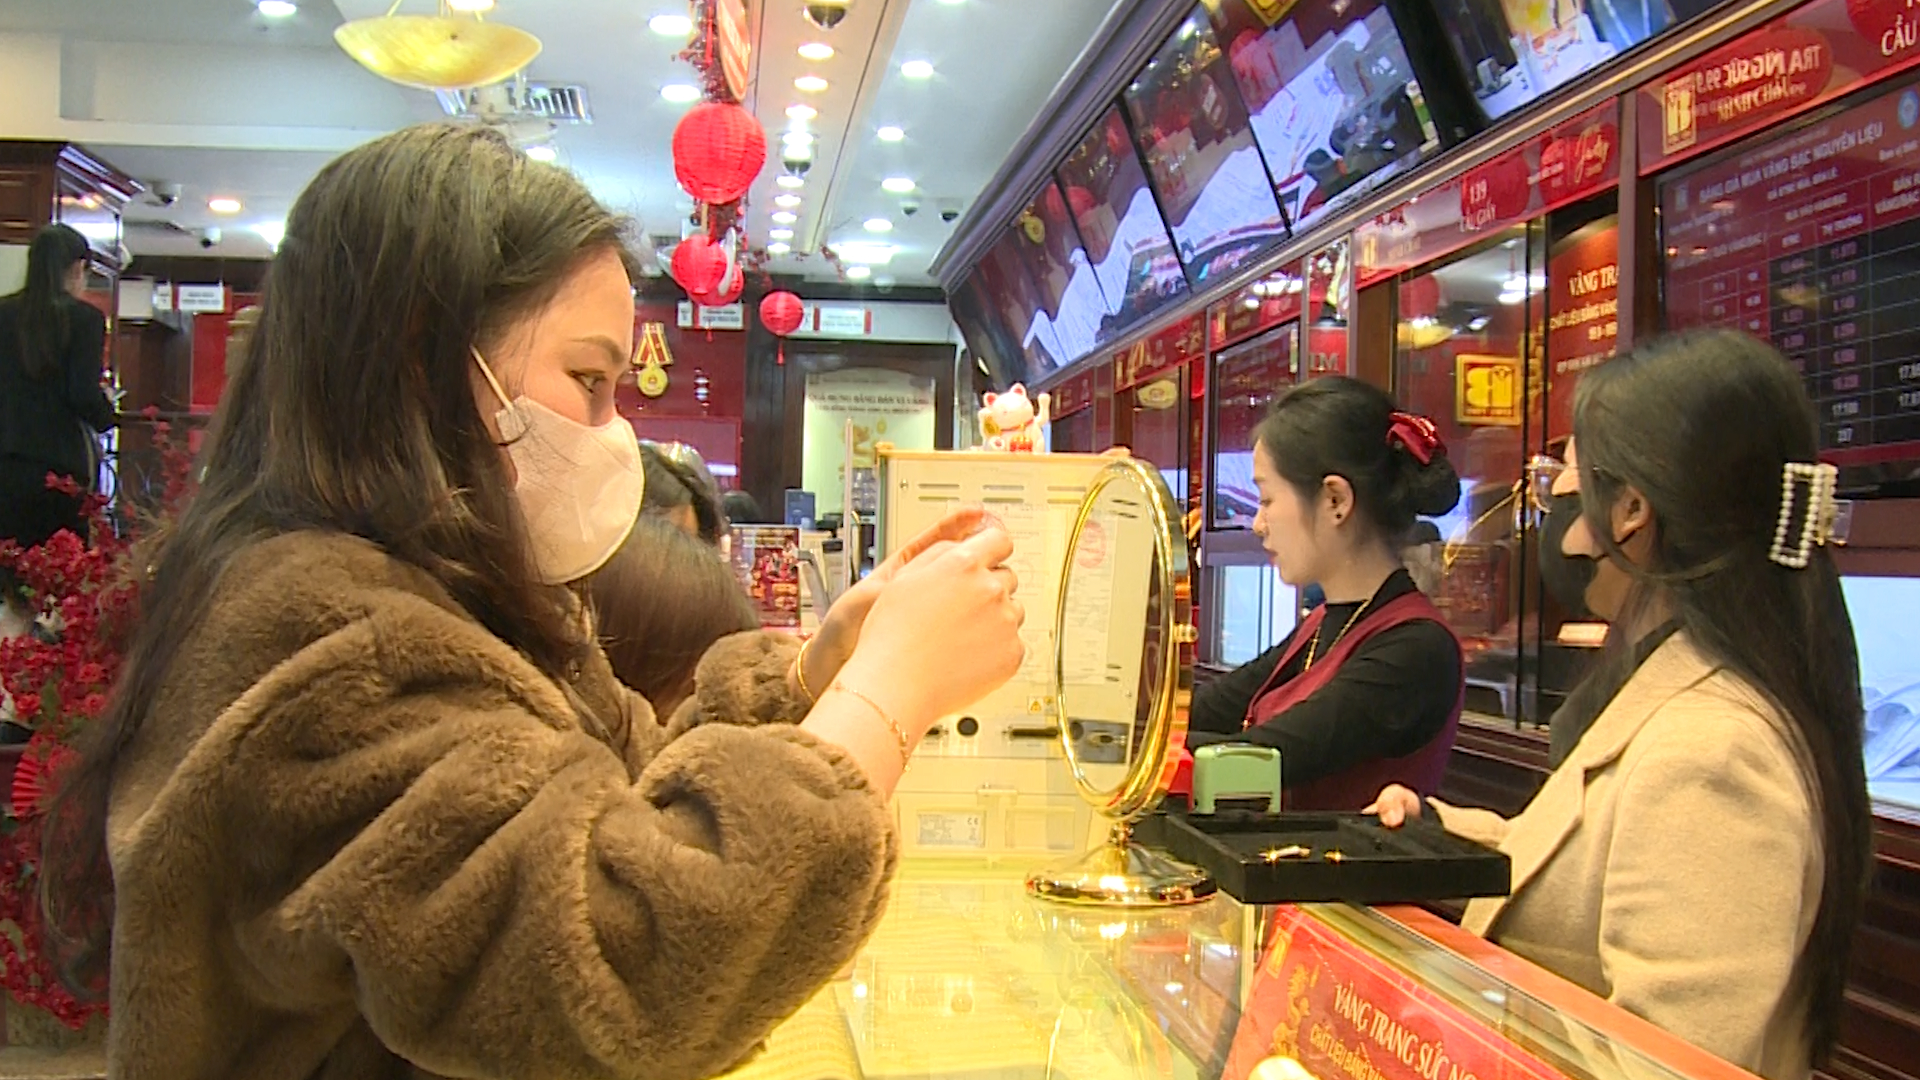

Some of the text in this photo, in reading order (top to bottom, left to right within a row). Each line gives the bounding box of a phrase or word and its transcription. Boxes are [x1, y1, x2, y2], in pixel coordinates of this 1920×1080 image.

[1881, 13, 1917, 56] CẦU
[1569, 269, 1598, 296] VÀNG
[1334, 981, 1372, 1031] VÀNG
[1369, 1008, 1419, 1066] TRANG
[1414, 1040, 1450, 1080] SỨC
